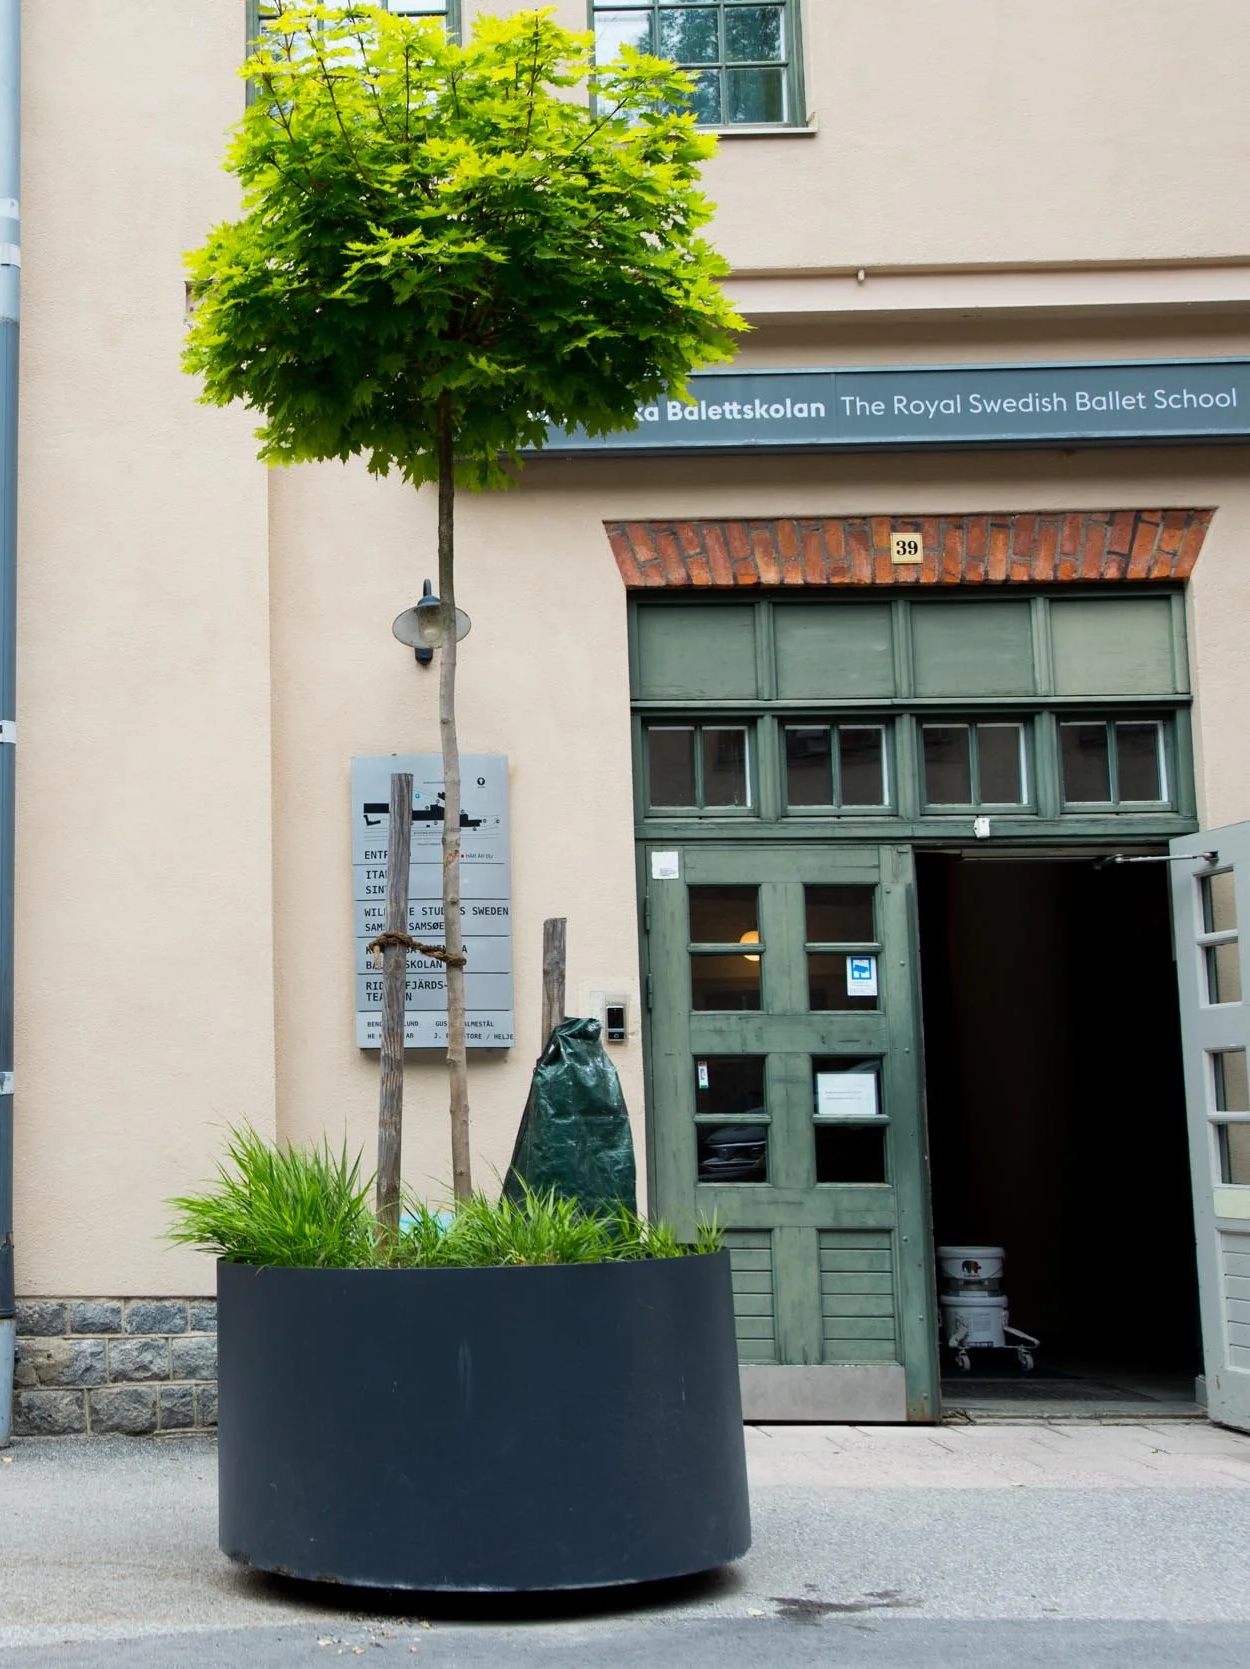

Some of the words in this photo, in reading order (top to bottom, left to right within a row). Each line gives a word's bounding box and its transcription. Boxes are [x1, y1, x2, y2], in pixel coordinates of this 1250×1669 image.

[666, 398, 826, 421] Balettskolan
[840, 396, 885, 416] The
[893, 394, 961, 419] Royal
[969, 391, 1067, 414] Swedish
[1076, 389, 1147, 412] Ballet
[1154, 387, 1238, 410] School
[896, 540, 919, 556] 39
[472, 906, 509, 916] SWEDEN
[408, 921, 445, 931] SAMSØE
[365, 979, 449, 991] RIDFJÄRDS-
